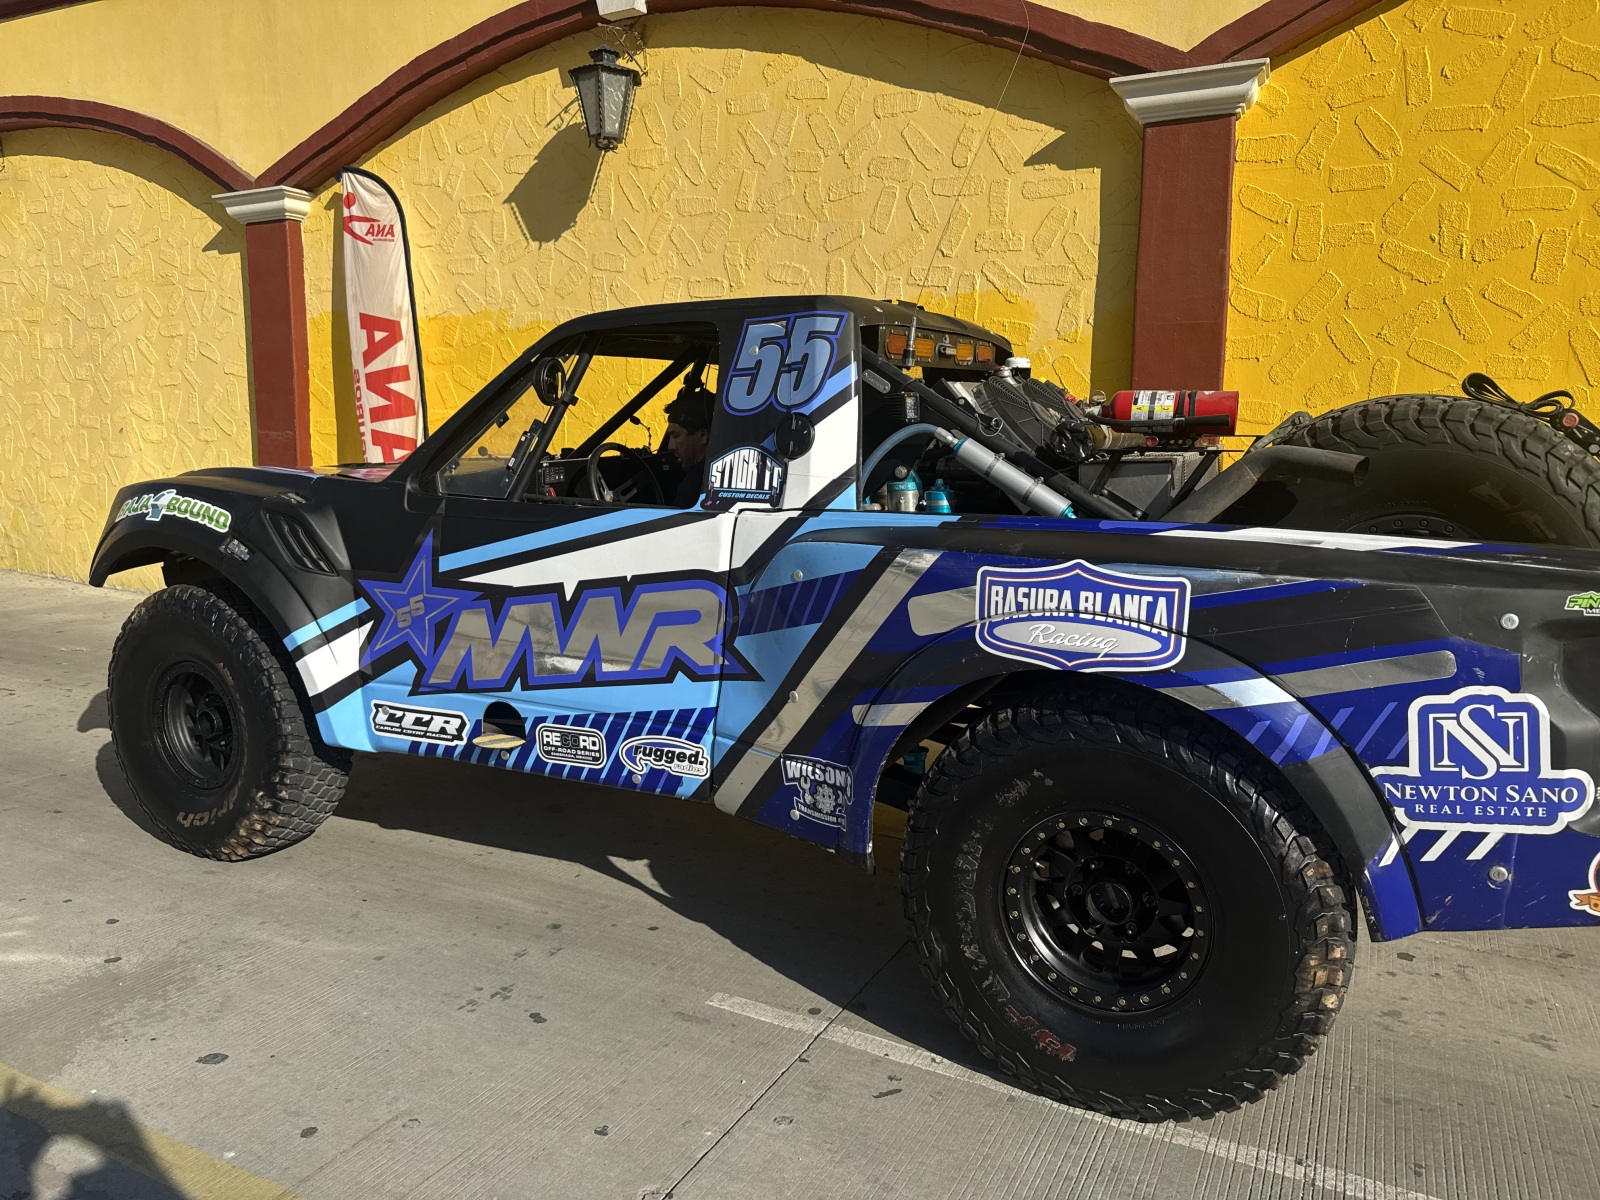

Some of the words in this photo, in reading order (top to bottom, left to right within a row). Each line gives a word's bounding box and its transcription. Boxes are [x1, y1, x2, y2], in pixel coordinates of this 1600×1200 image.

[725, 313, 846, 414] 55
[711, 448, 759, 490] STICK
[116, 494, 153, 522] BAJA
[165, 496, 231, 532] BOUND
[397, 594, 425, 628] 55
[990, 585, 1074, 622] BASURA
[1078, 591, 1168, 638] BLANCA
[424, 583, 736, 688] MWR
[1028, 623, 1119, 659] Racing
[375, 708, 462, 735] CCR
[543, 731, 599, 750] RECORD
[543, 746, 576, 754] OFF-ROAD
[673, 763, 705, 773] radios
[1384, 782, 1497, 803] NEWTON
[1506, 784, 1578, 804] SANO
[798, 803, 837, 823] TRANSMISSION
[1415, 803, 1465, 815] REAL
[1475, 805, 1548, 818] ESTATE
